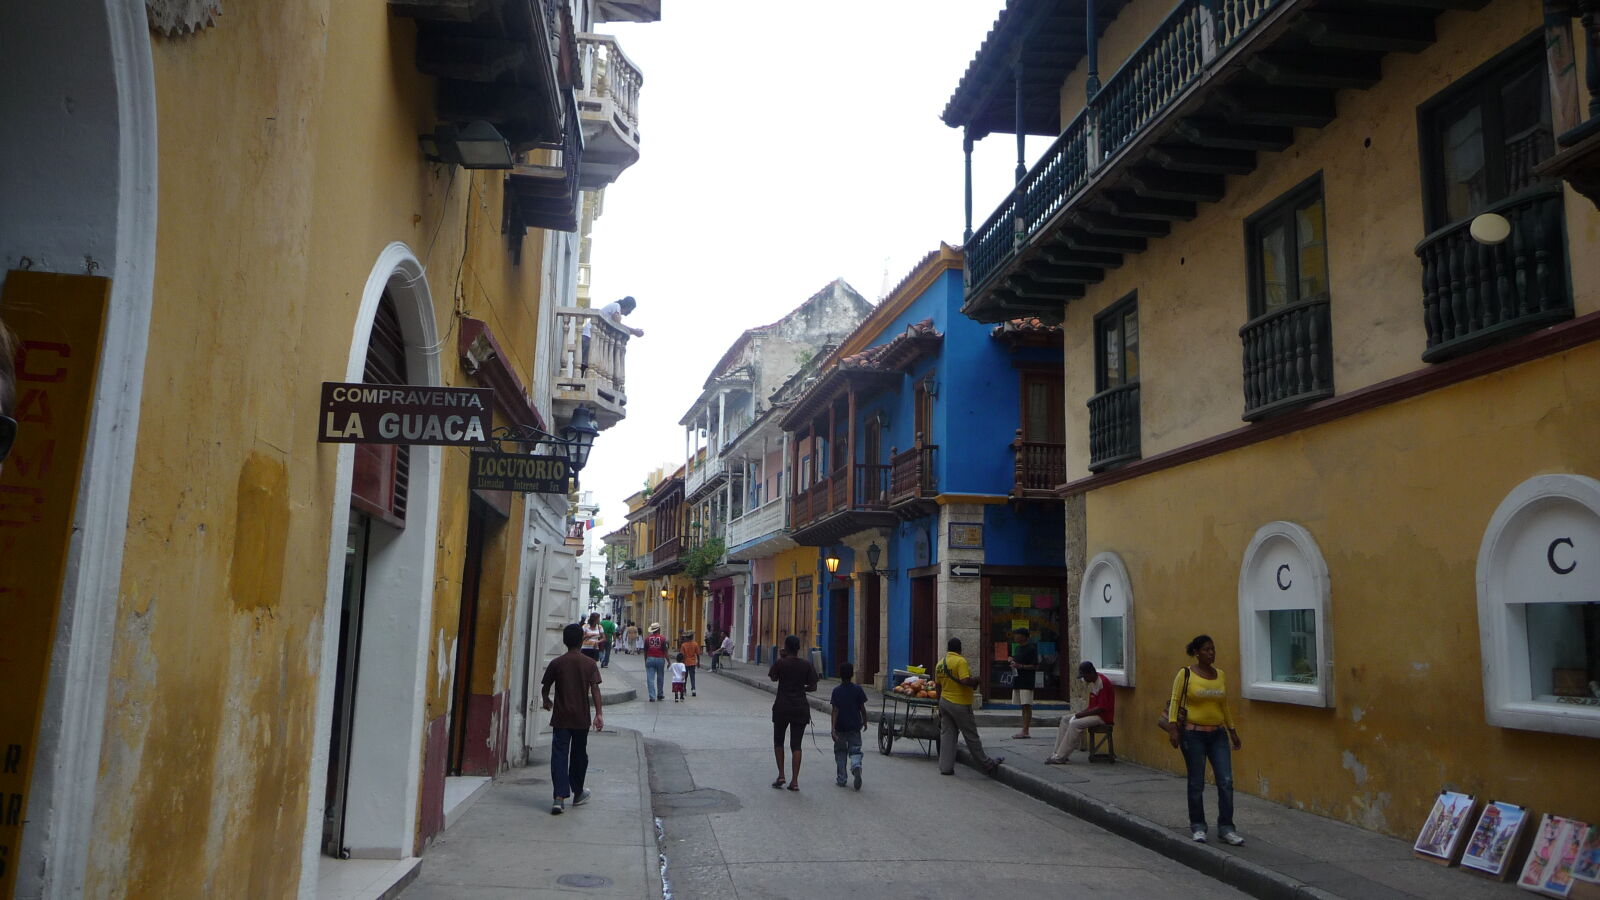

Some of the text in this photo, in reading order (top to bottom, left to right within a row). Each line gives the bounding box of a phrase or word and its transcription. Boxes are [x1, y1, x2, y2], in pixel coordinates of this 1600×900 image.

[332, 387, 482, 408] COMPRAVENTA
[325, 411, 486, 442] LA GUACA
[477, 456, 565, 480] LOCUTORIO
[513, 479, 540, 491] Internet
[549, 480, 560, 492] Fax
[1547, 537, 1577, 575] C
[1276, 564, 1292, 591] C
[1103, 583, 1112, 603] C
[648, 636, 662, 647] 54
